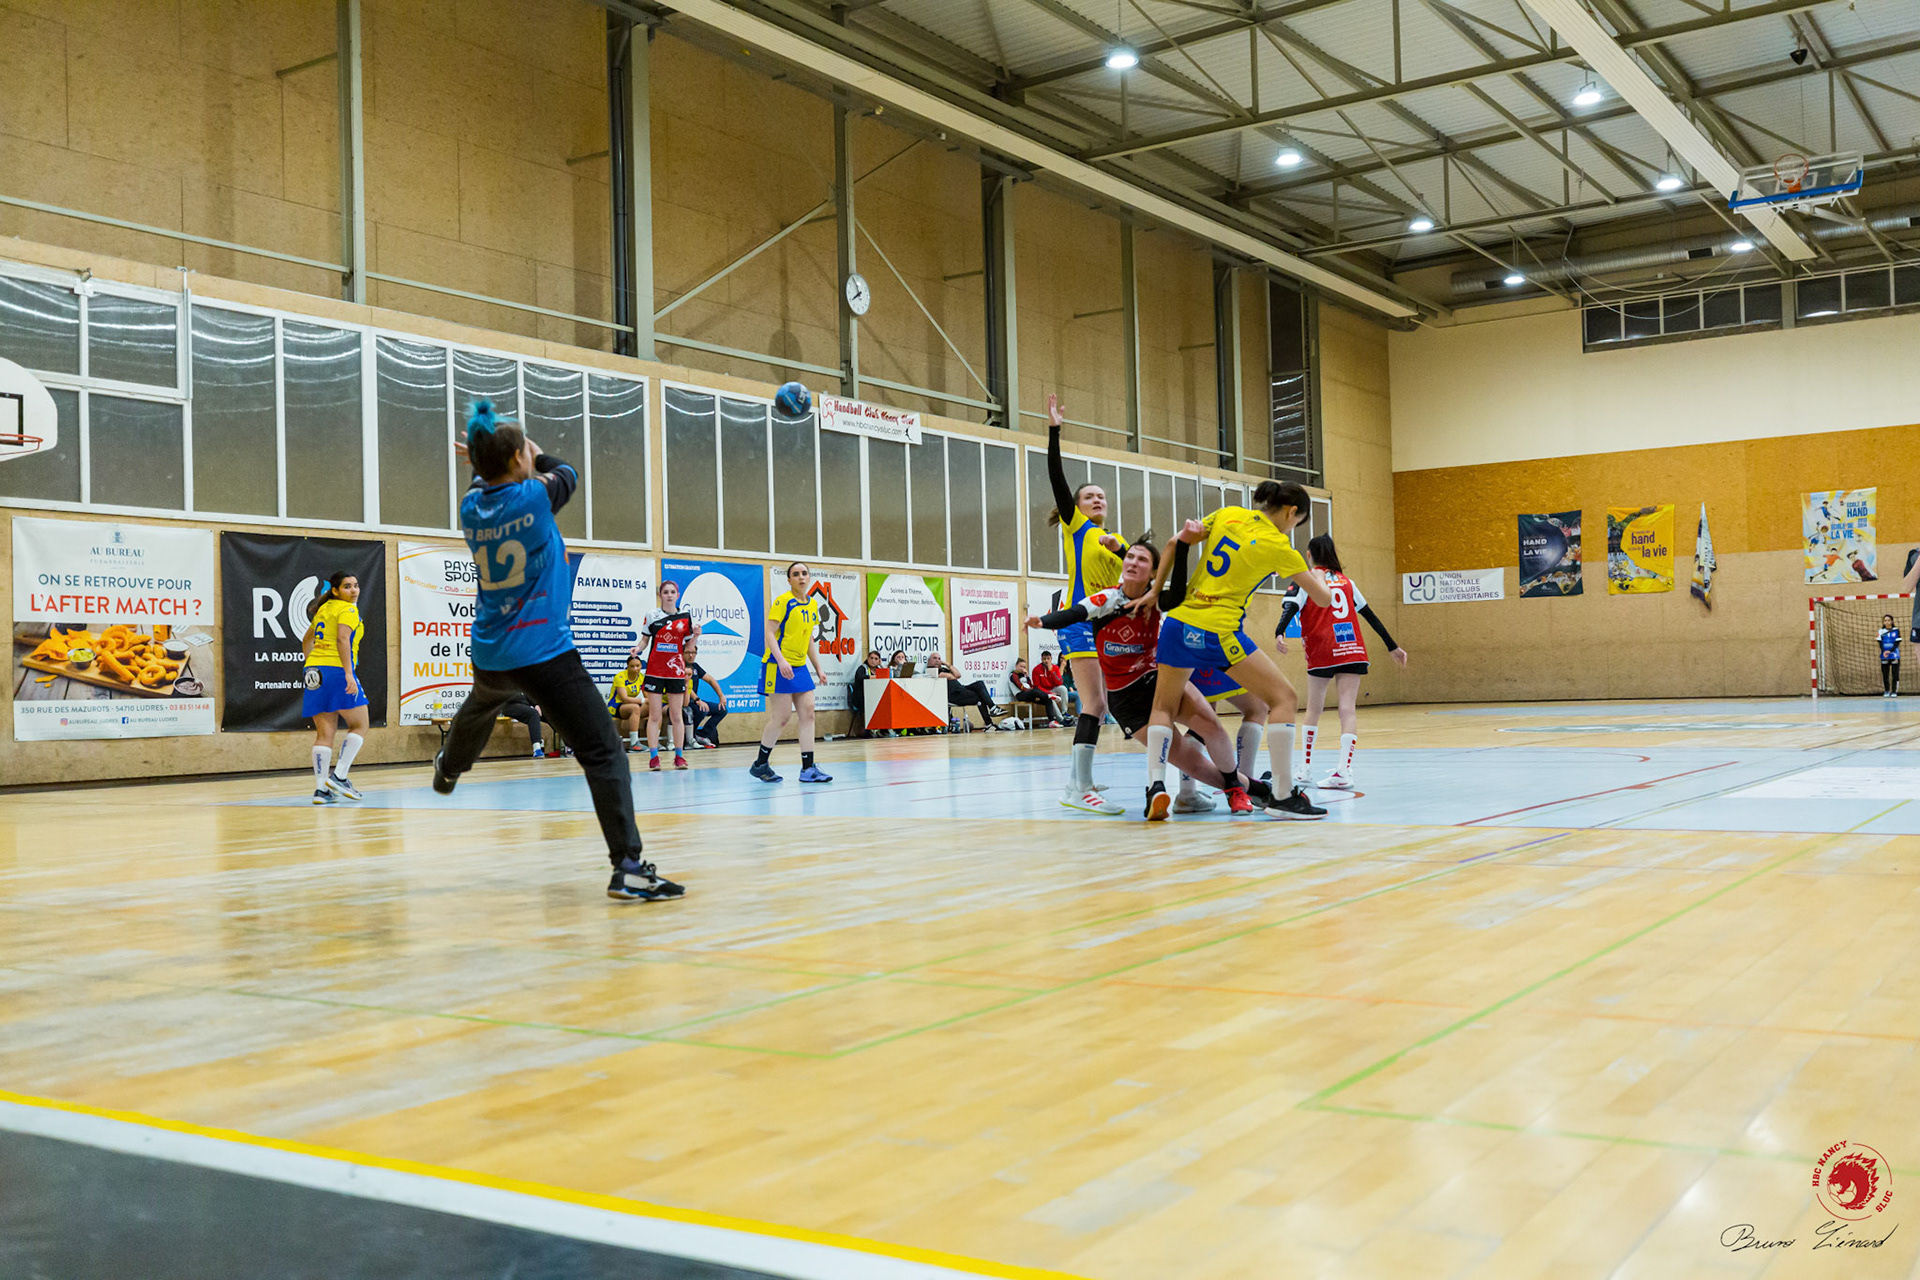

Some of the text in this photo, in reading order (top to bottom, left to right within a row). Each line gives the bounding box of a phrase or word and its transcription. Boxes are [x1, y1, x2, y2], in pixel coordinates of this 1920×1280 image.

[834, 400, 862, 416] Handball
[864, 406, 880, 420] Club
[1847, 506, 1868, 518] HAND
[476, 513, 534, 542] BRUTTO
[1631, 531, 1655, 545] hand
[1830, 530, 1854, 540] LA VIE
[1523, 538, 1548, 546] HAND
[90, 547, 144, 557] AU BUREAU
[1206, 535, 1241, 578] 5
[1642, 544, 1668, 558] la vie
[444, 560, 478, 572] PAYS
[473, 540, 528, 591] 12
[38, 573, 192, 590] ON SE RETROUVE POUR
[577, 576, 647, 590] RAYAN DEM 54
[1440, 578, 1480, 586] NATIONALE
[1440, 592, 1500, 601] UNIVERSITAIRES
[115, 596, 186, 616] MATCH
[192, 598, 202, 616] ?
[573, 602, 619, 611] Déménagement
[1330, 588, 1349, 620] 9
[706, 604, 745, 622] Hoquet
[800, 609, 810, 624] 11
[574, 617, 602, 625] Transport
[666, 620, 673, 630] 2
[902, 620, 912, 630] LE
[314, 622, 325, 640] 6
[965, 616, 983, 643] Cave
[987, 612, 1006, 638] Léon
[1186, 631, 1201, 643] AZ
[430, 643, 450, 657] de
[874, 636, 939, 652] COMPTOIR
[254, 652, 305, 662] LA RADIO
[965, 661, 1007, 670] 03 83 17 84 57
[254, 680, 301, 689] Partenaire du
[441, 690, 452, 698] 03
[136, 704, 164, 712] LUDRES
[749, 699, 760, 707] 077
[1159, 738, 1169, 764] Kempa
